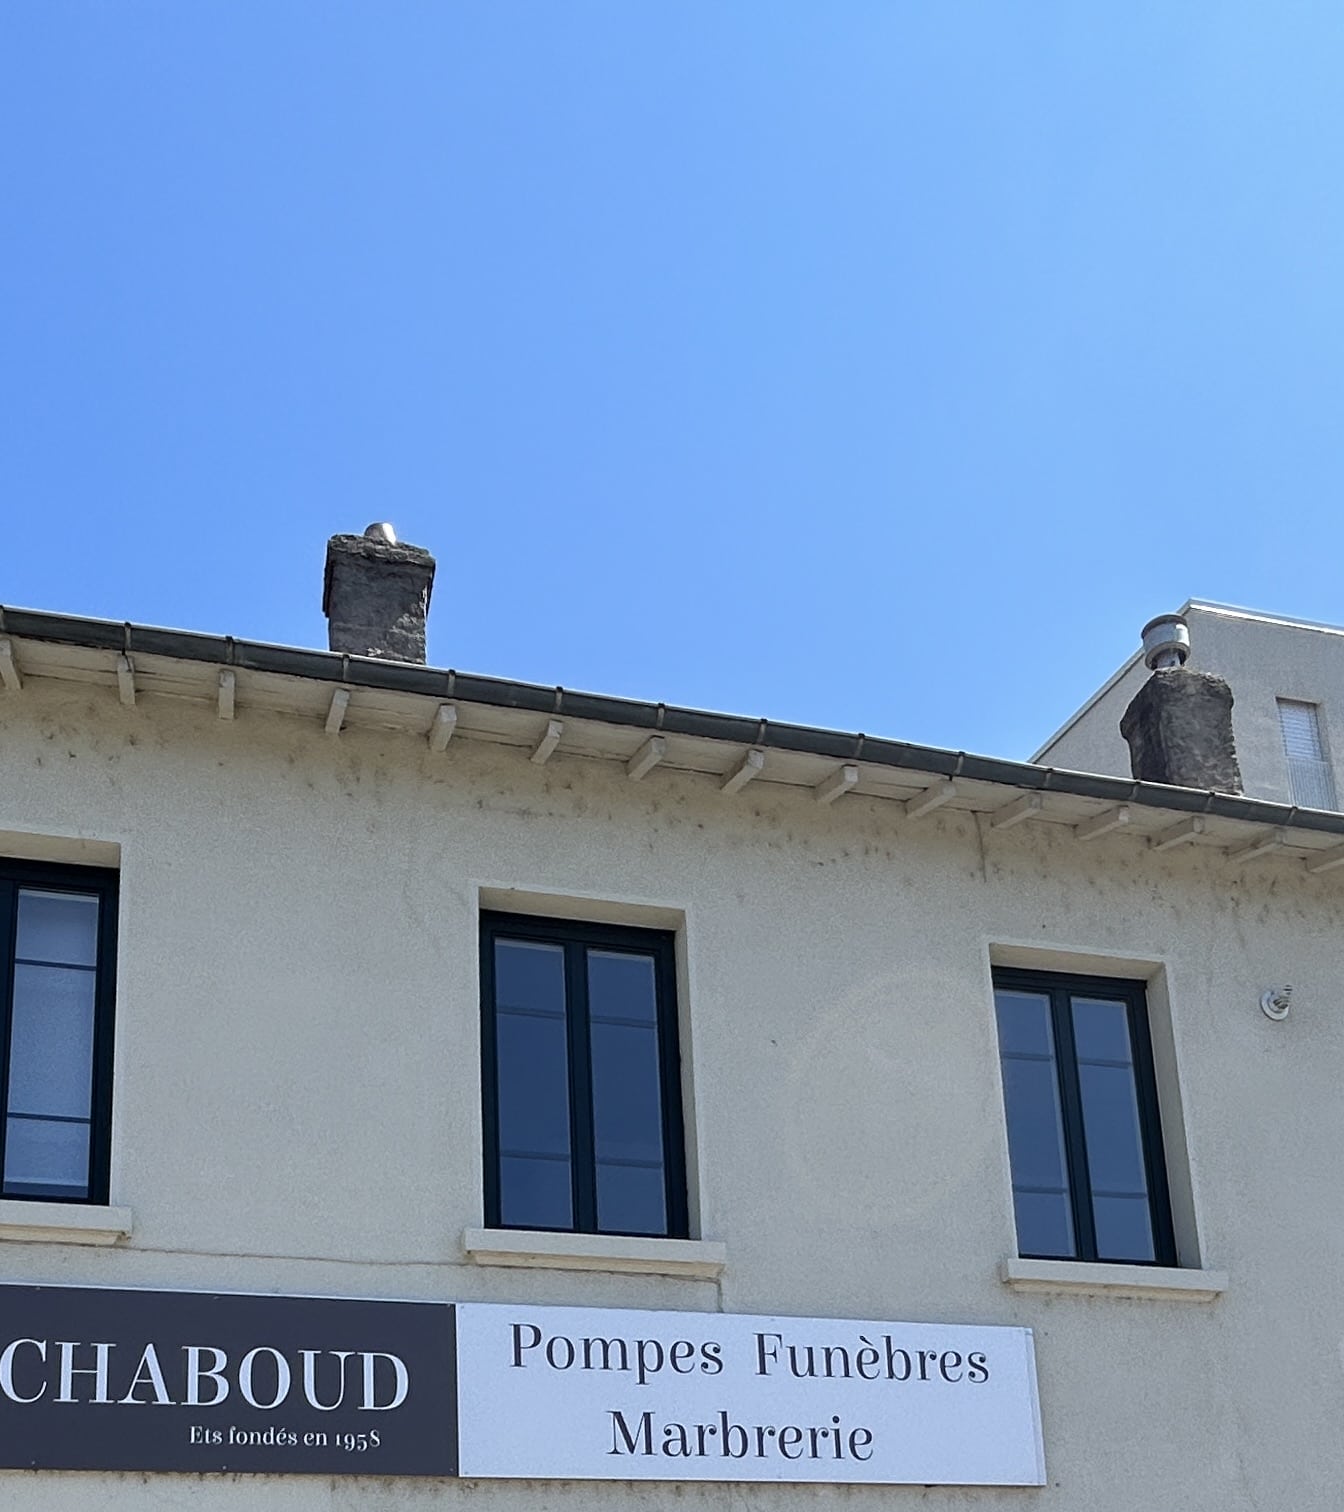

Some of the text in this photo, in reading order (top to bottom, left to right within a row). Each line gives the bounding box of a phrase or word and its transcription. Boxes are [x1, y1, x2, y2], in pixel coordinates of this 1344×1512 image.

[508, 1321, 991, 1386] Pompes Funèbres
[189, 1425, 381, 1452] Ets fondés en 1958
[606, 1409, 875, 1462] Marbrerie
